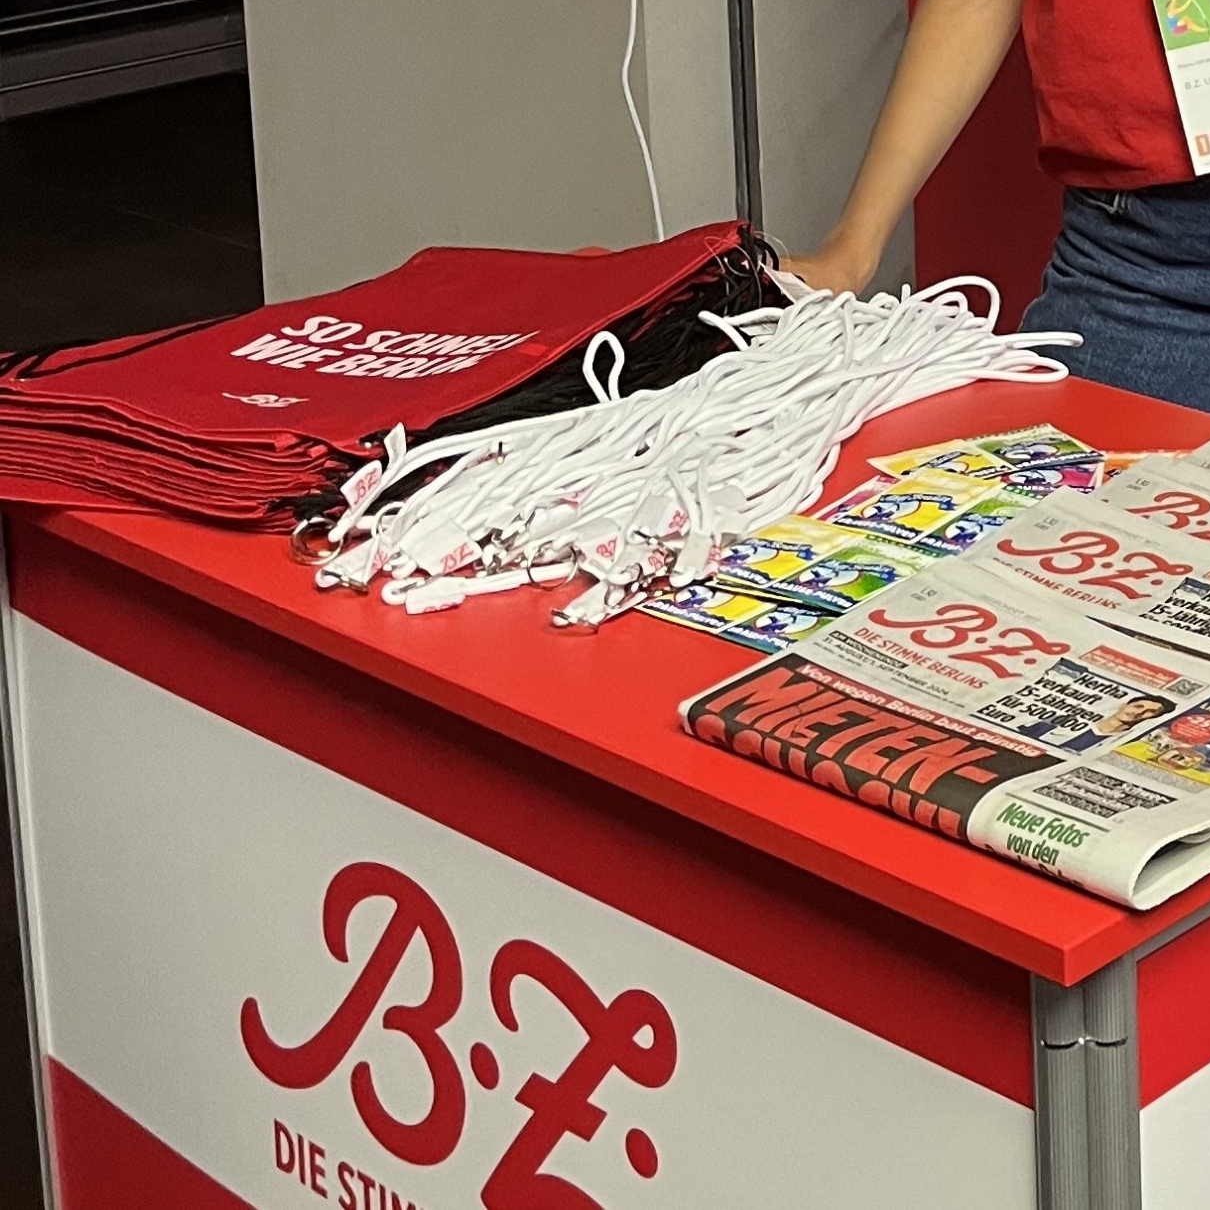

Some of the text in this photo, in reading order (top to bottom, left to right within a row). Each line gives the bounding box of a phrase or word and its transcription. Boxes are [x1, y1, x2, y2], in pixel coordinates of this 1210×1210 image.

[281, 315, 363, 344] SO
[230, 333, 344, 369] WIE
[853, 627, 880, 645] DIE
[876, 639, 932, 667] STIMME
[927, 660, 990, 690] BERLINS
[996, 694, 1023, 710] für
[1034, 675, 1104, 706] verkauft
[1073, 671, 1129, 700] Hertha
[801, 664, 832, 685] Von
[833, 678, 886, 707] wegen
[886, 699, 934, 724] Berlin
[933, 715, 977, 739] baut
[974, 729, 1046, 759] günstig
[976, 702, 1017, 723] Euro
[1015, 684, 1105, 724] 15-Jährigen
[705, 666, 999, 796] MIETEN-
[996, 802, 1090, 848] Neue Fotos
[1006, 833, 1033, 857] von
[1031, 839, 1060, 867] den
[273, 1121, 328, 1200] DIE
